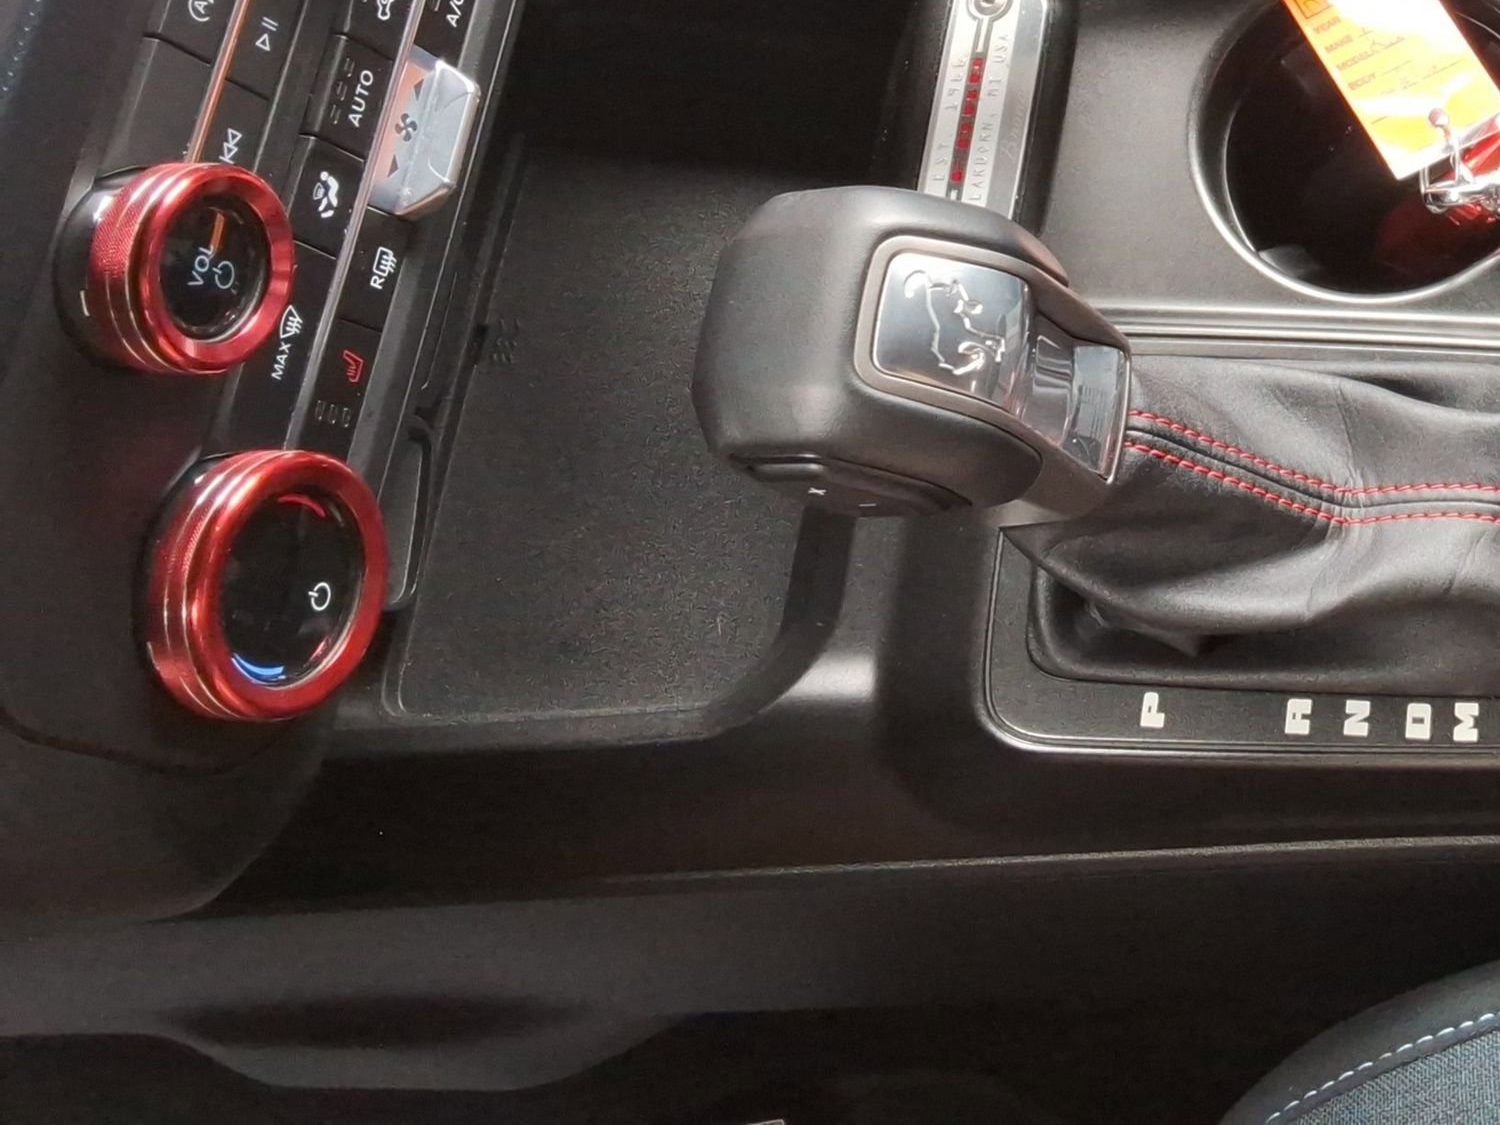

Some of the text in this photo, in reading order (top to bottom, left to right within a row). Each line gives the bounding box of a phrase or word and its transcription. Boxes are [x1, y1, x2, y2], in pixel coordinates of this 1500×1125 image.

[348, 70, 374, 127] AUTO
[187, 245, 213, 285] VOL
[271, 343, 292, 380] MAX
[1140, 692, 1165, 728] P
[1284, 698, 1312, 735] R
[1343, 699, 1371, 737] N
[1405, 703, 1432, 740] D
[1453, 702, 1479, 742] M
